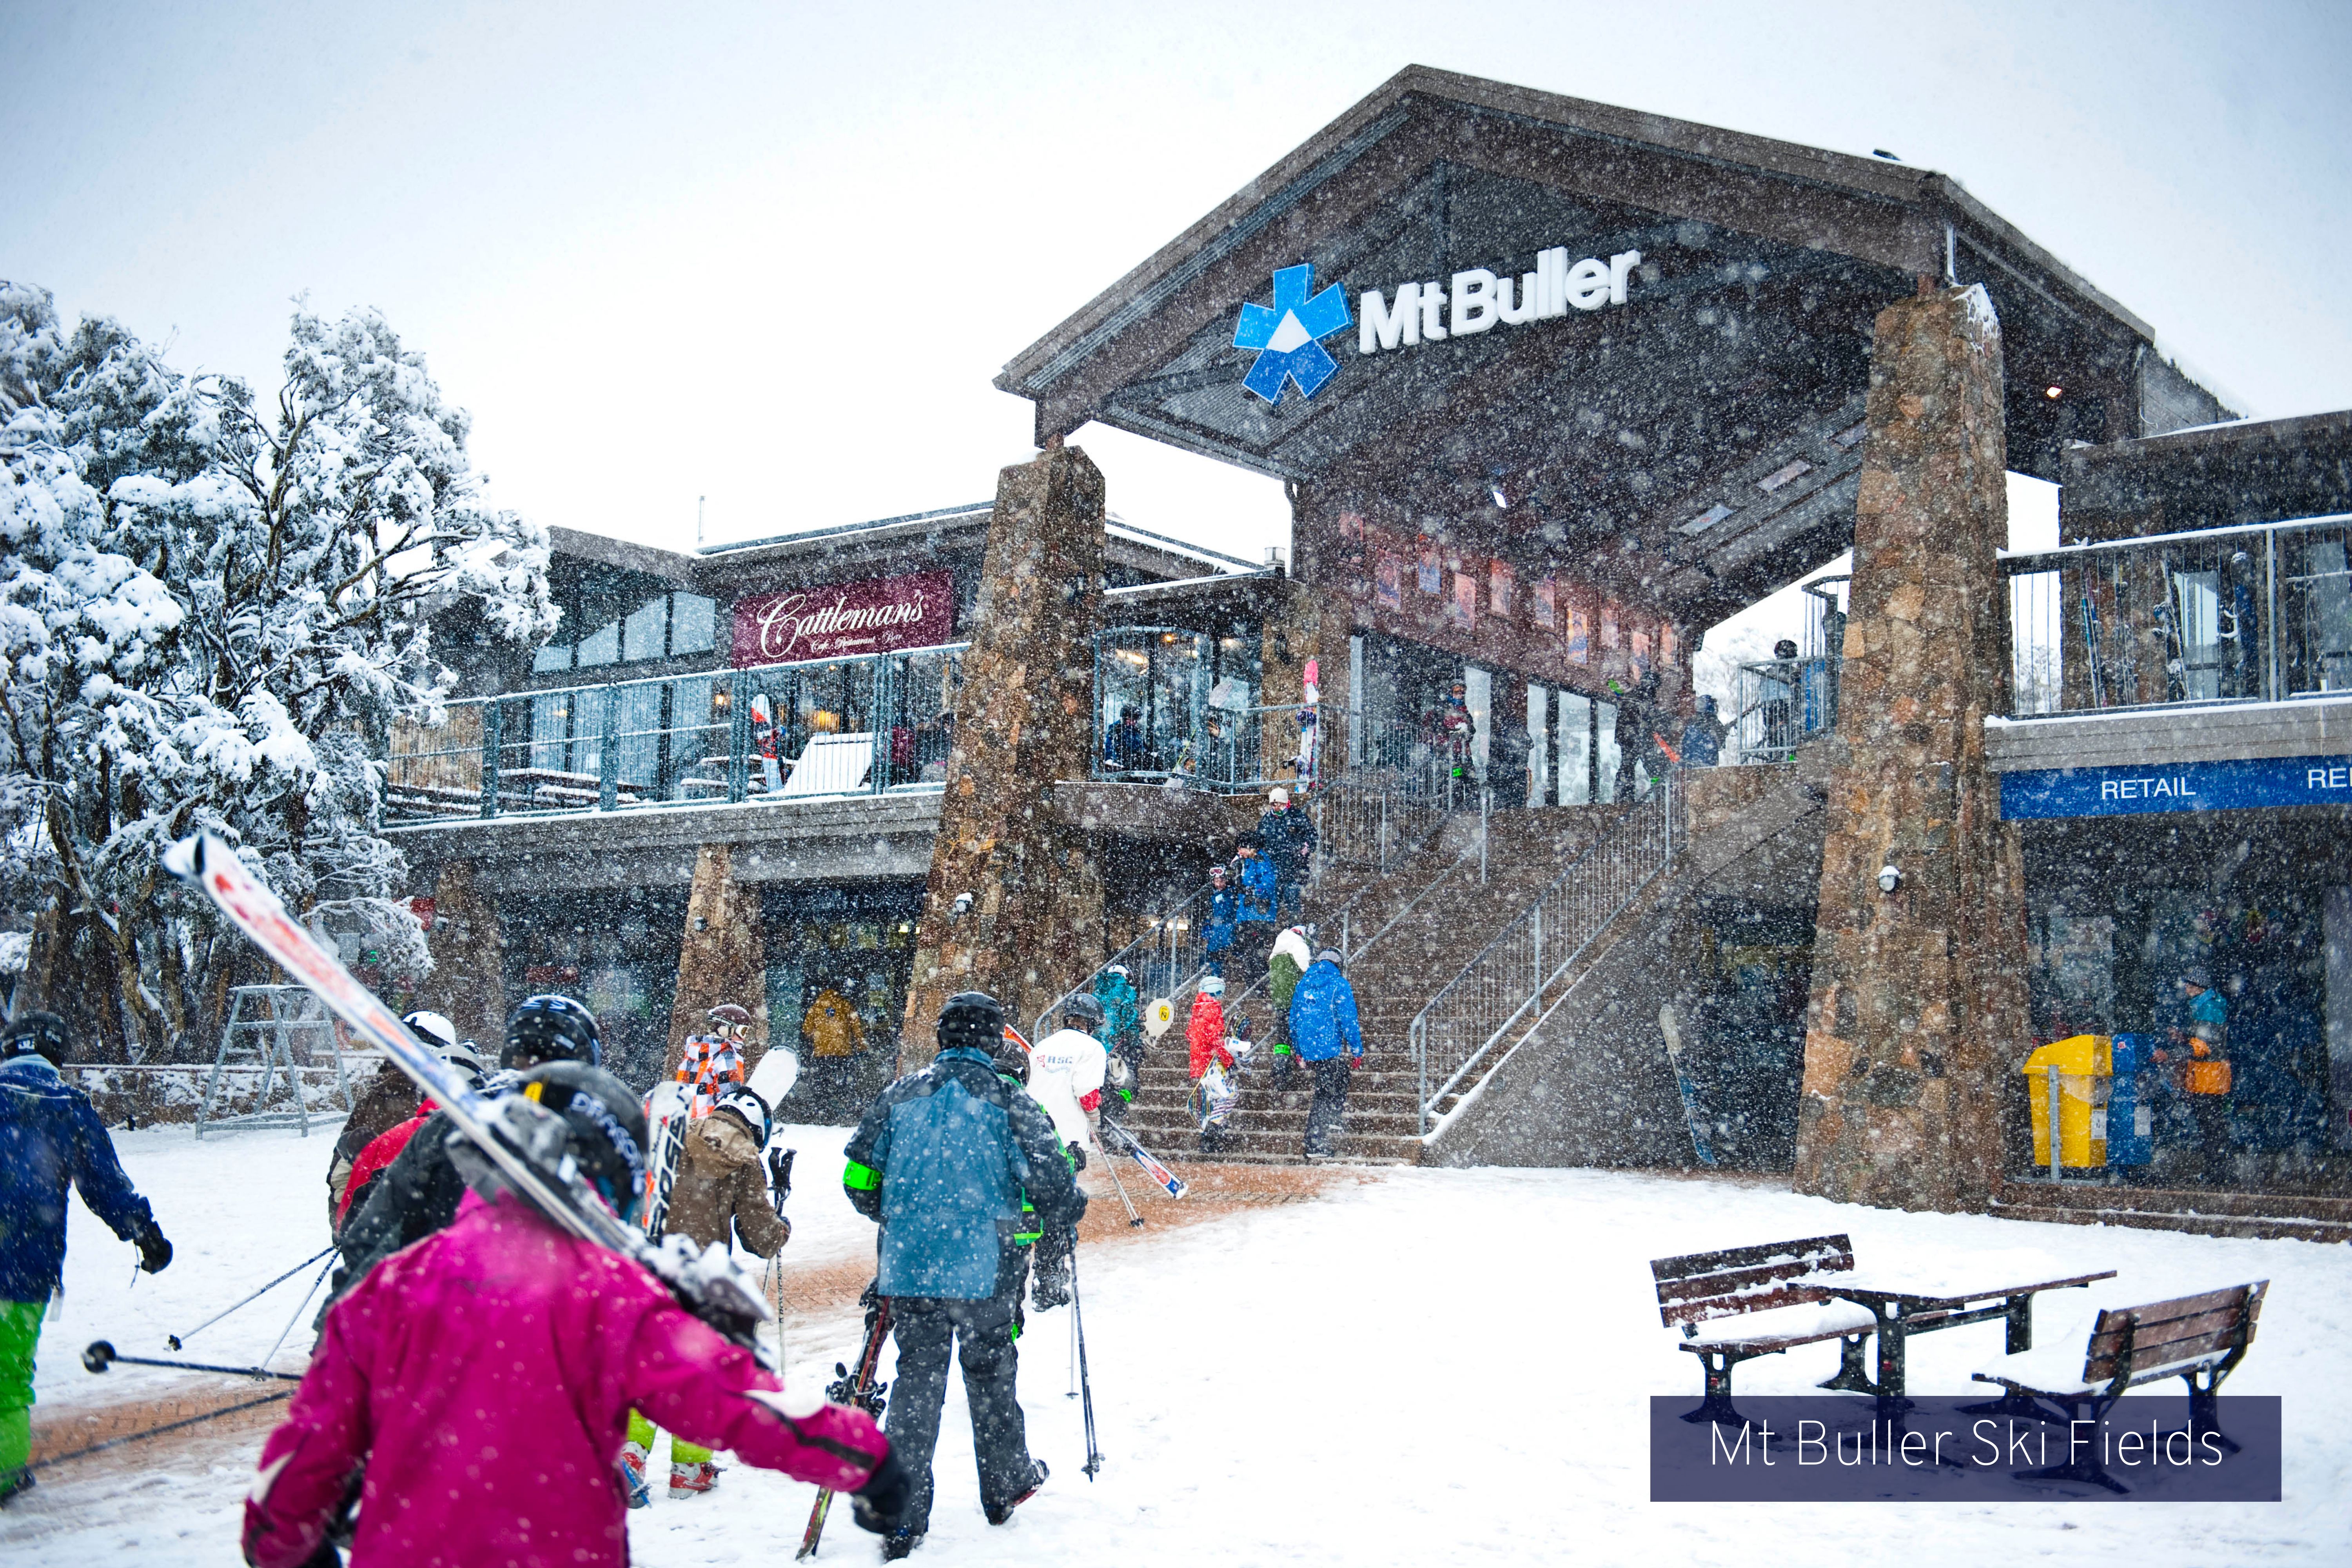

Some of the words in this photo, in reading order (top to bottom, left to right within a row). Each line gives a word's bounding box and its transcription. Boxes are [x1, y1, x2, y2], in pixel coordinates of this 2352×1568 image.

[757, 593, 924, 658] Cattleman's
[834, 635, 876, 650] Restaurant
[882, 630, 902, 644] Bar
[2102, 777, 2196, 800] RETAIL
[2308, 767, 2352, 789] RE
